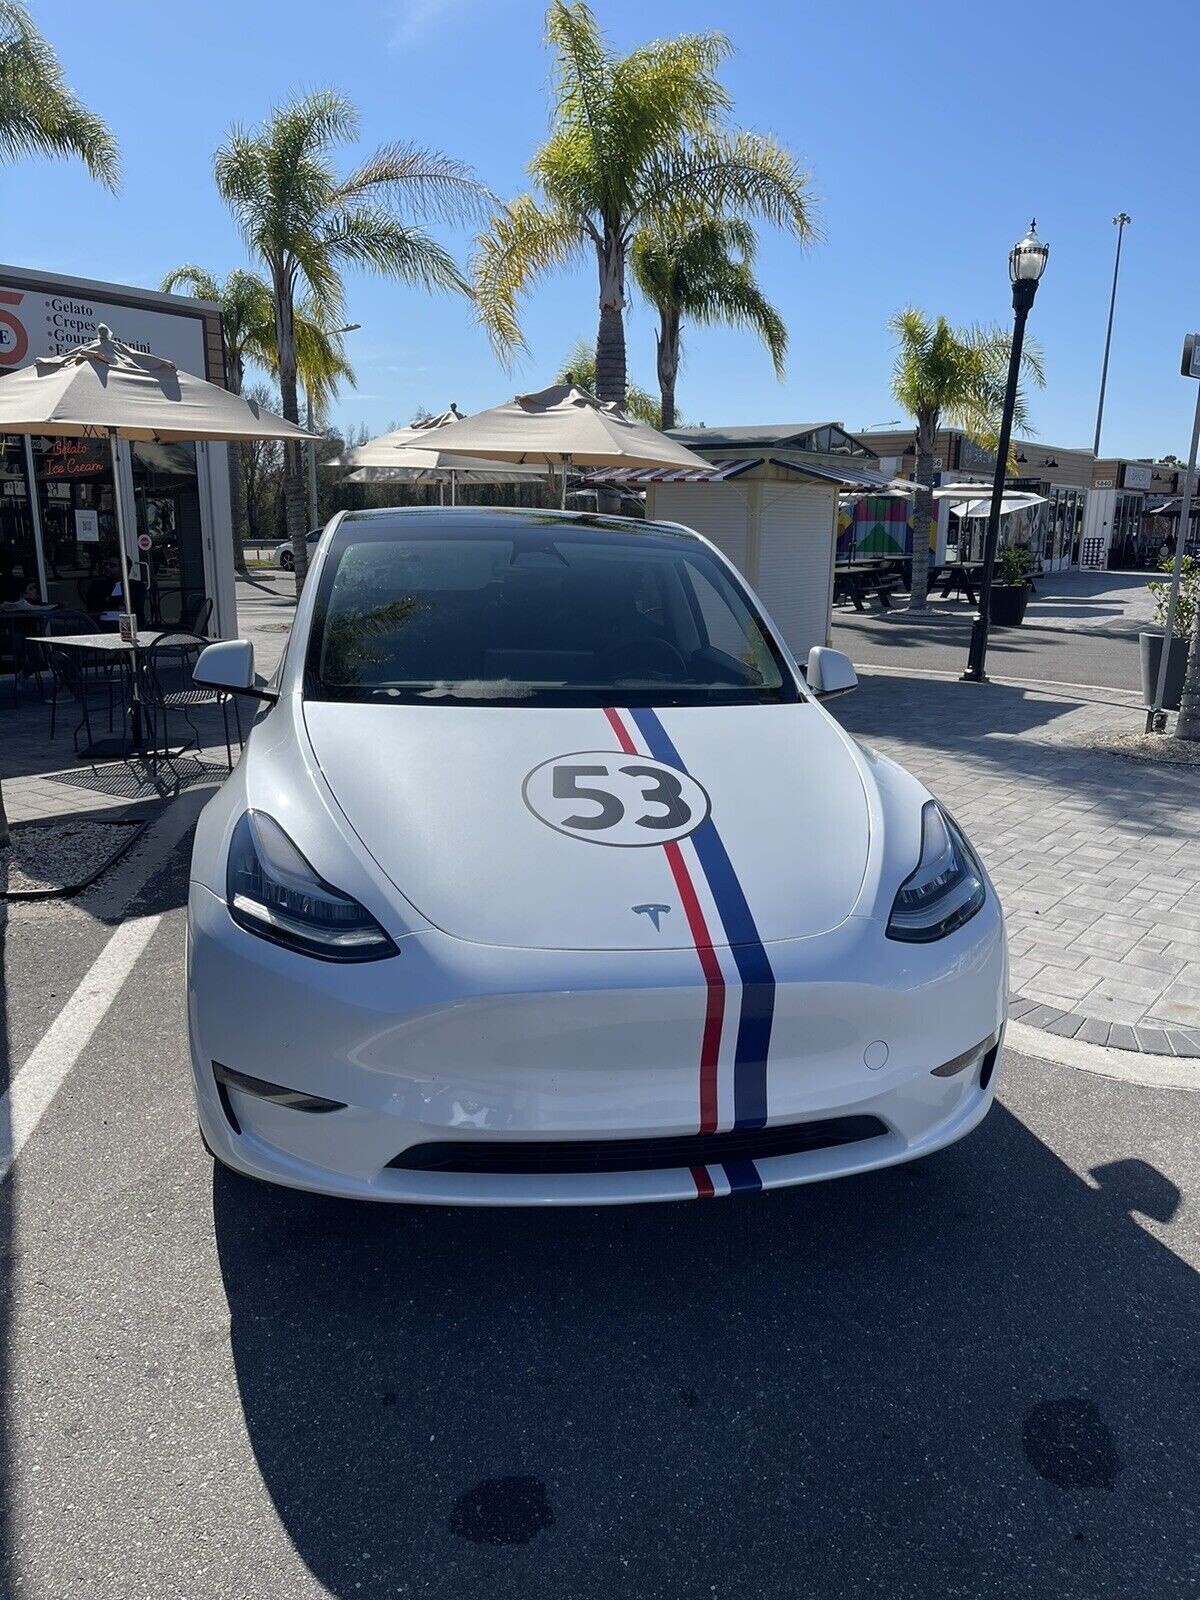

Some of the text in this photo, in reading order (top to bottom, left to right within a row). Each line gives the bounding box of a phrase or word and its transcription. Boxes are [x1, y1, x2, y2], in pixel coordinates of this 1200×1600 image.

[51, 298, 93, 316] Gelato
[52, 313, 97, 332] Crepes
[113, 337, 151, 353] nini
[52, 440, 90, 456] Gelato
[46, 458, 104, 476] Ice Cream
[552, 765, 692, 830] 53
